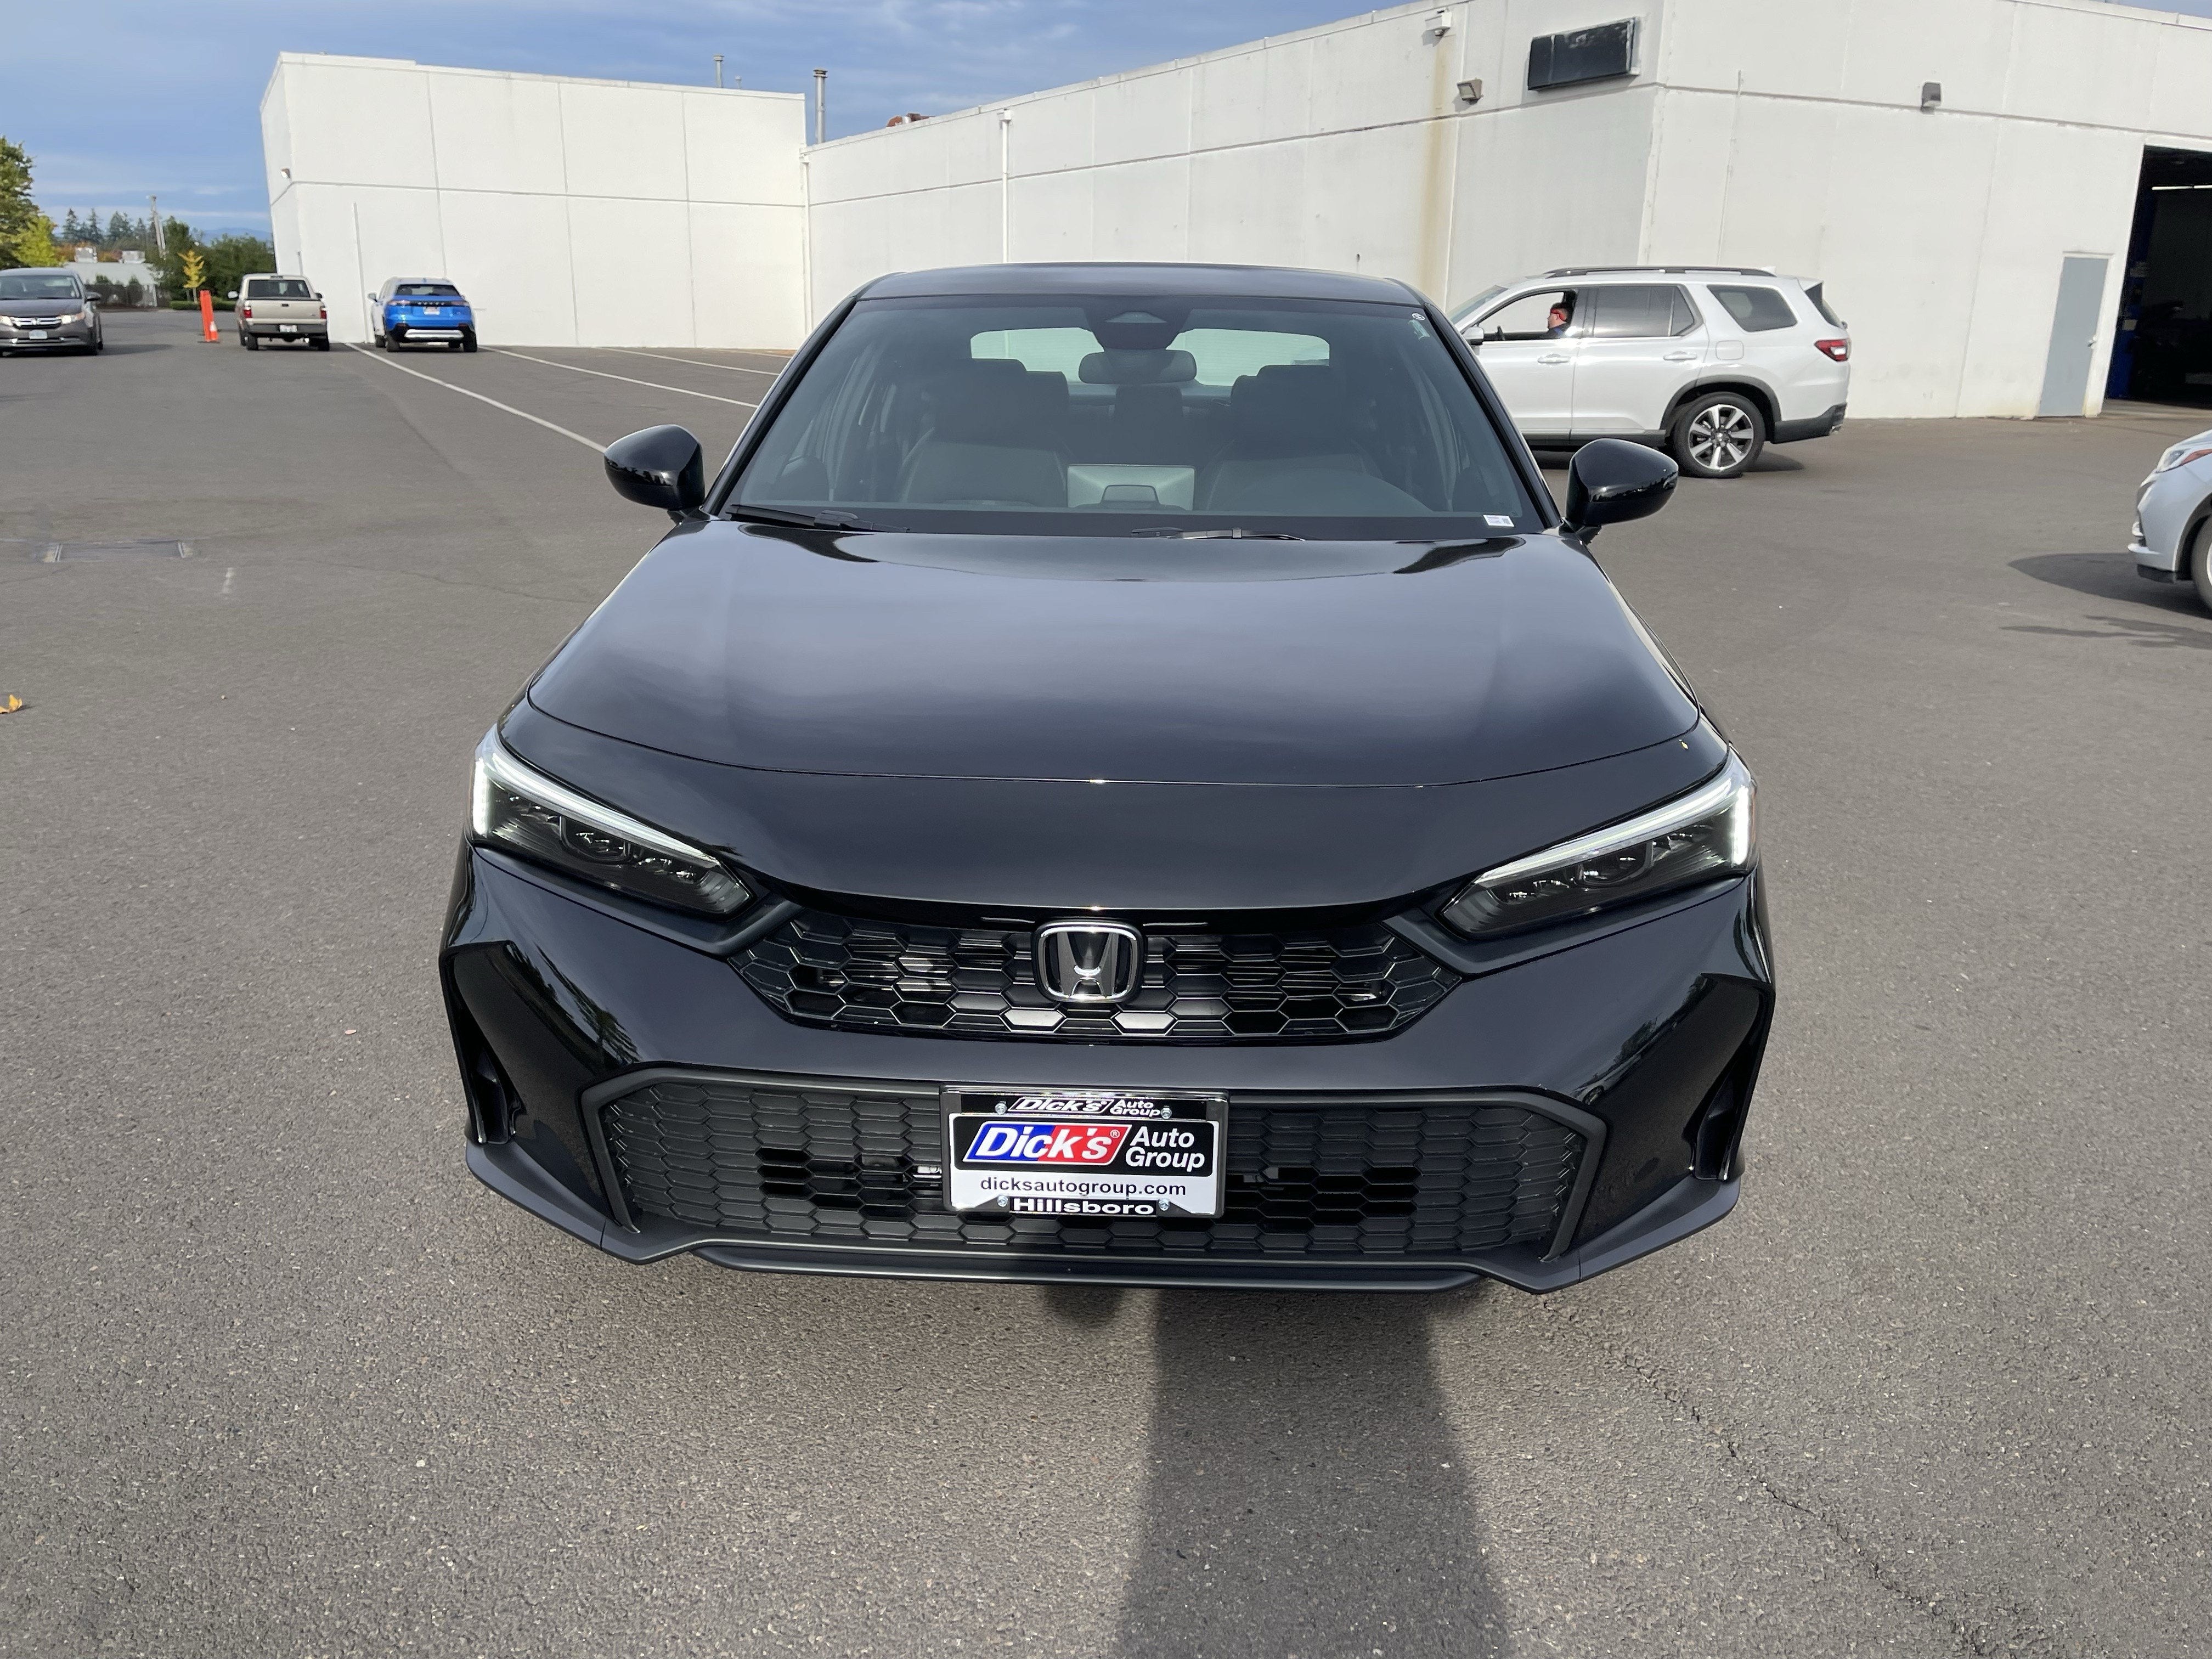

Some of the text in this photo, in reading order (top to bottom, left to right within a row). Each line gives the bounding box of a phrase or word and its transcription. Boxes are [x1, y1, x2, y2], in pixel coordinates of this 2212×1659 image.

[1015, 1099, 1102, 1112] Dick's
[1110, 1107, 1161, 1118] Group
[1113, 1099, 1154, 1109] Auto
[975, 1126, 1112, 1160] Dick's
[1130, 1126, 1195, 1148] Auto
[1125, 1147, 1205, 1172] Group
[980, 1177, 1187, 1197] dicksautogroup.com
[1013, 1198, 1154, 1215] Hillsboro
